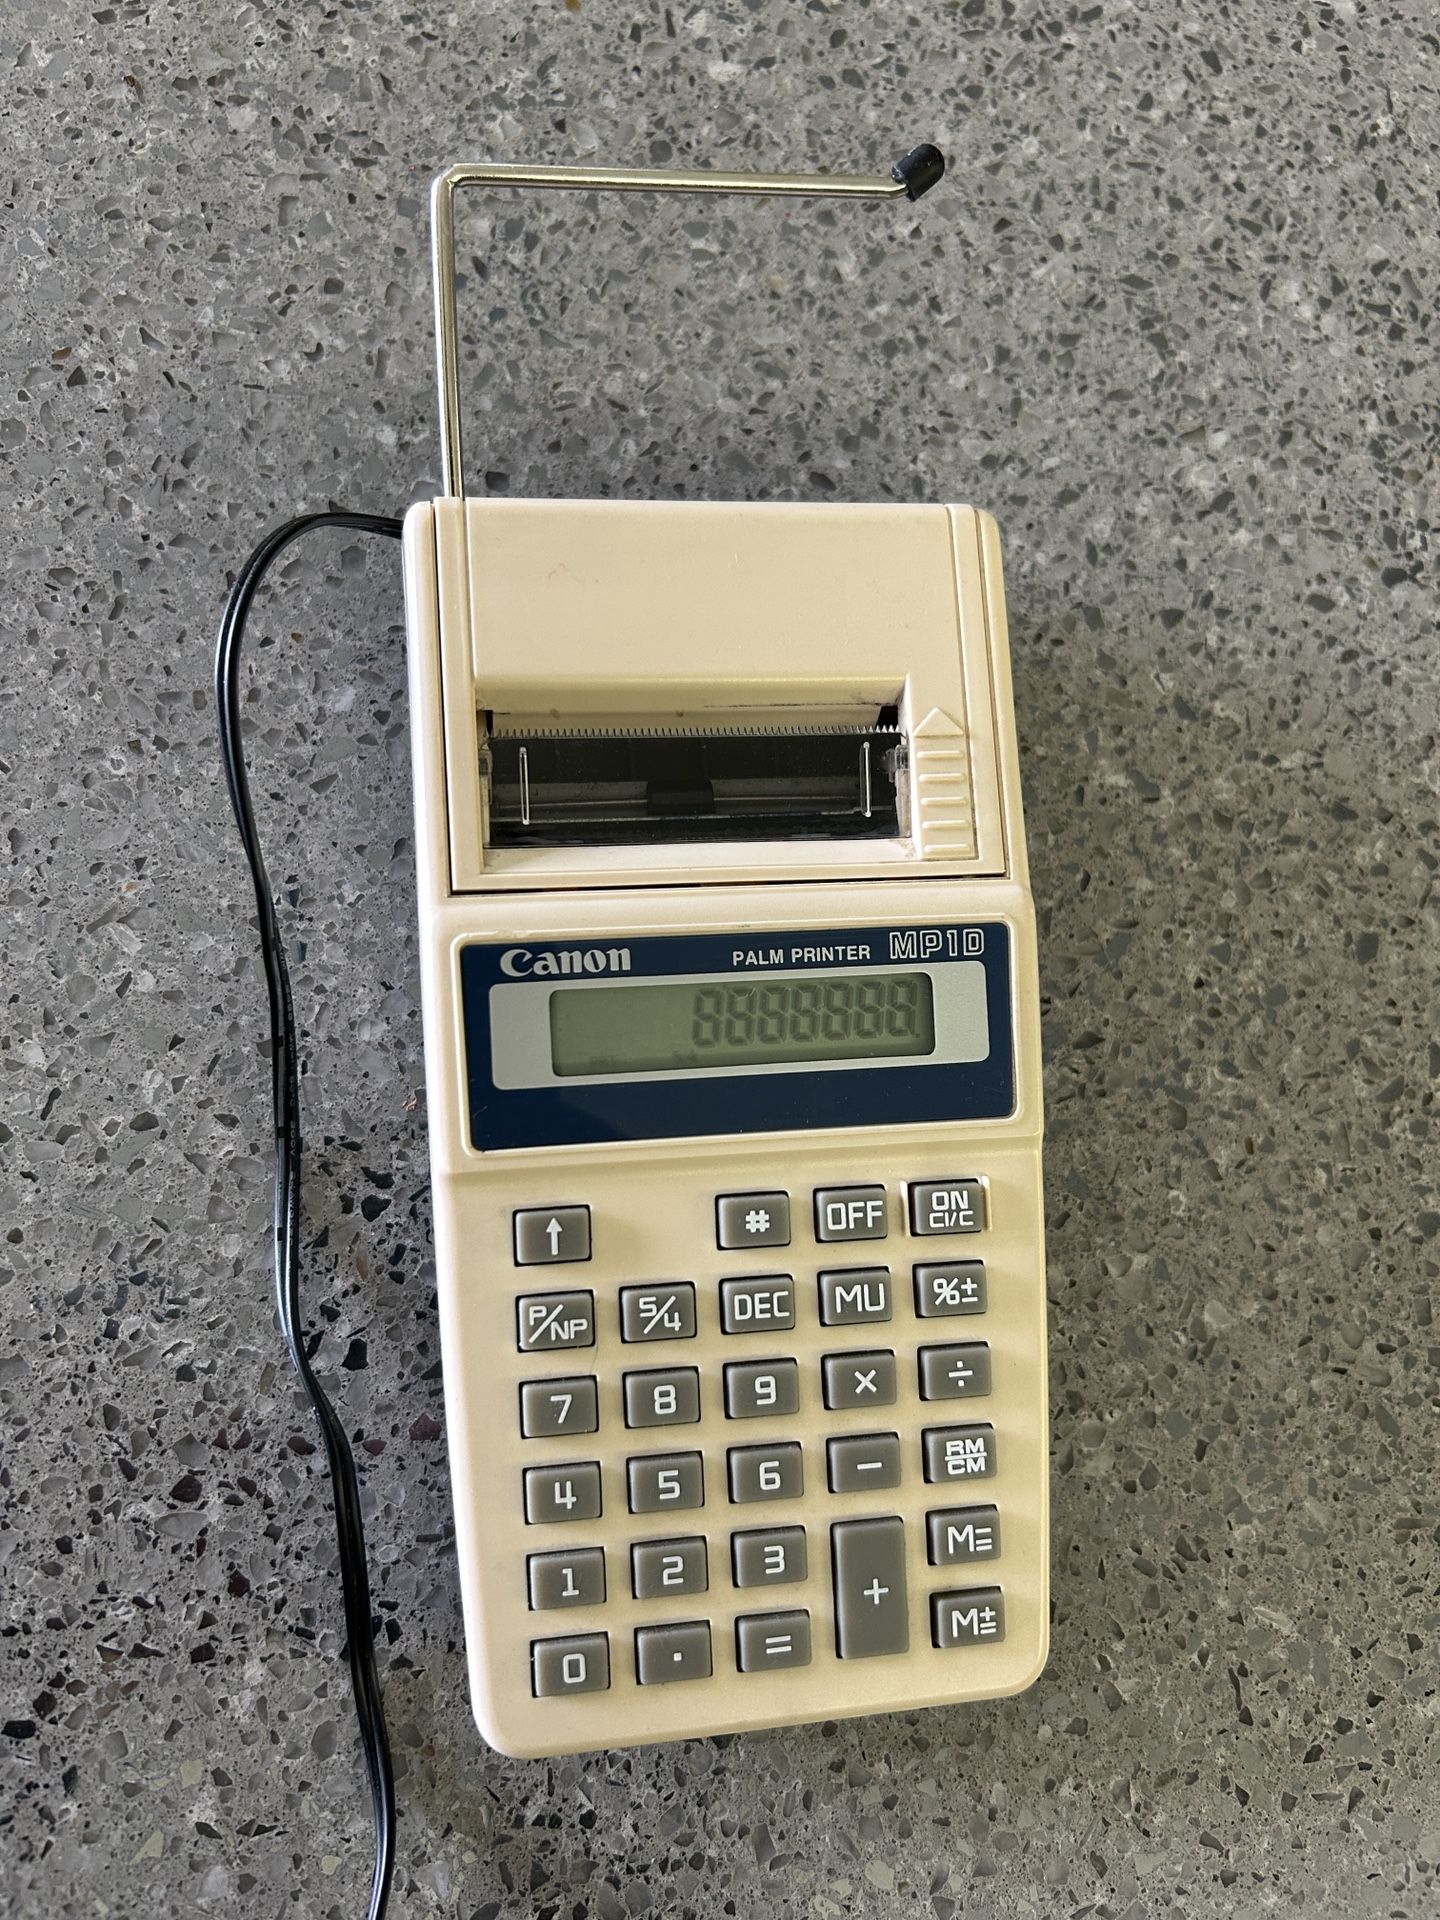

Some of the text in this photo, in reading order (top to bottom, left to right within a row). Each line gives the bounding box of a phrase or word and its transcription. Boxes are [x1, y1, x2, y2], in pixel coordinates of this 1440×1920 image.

[733, 928, 985, 966] PALM PRINTER MP1D
[500, 948, 631, 978] Canon
[932, 1190, 969, 1211] ON
[746, 1210, 769, 1232] #
[827, 1200, 883, 1231] OFF
[734, 1291, 789, 1320] DEC
[836, 1283, 884, 1313] MU
[639, 1296, 681, 1334] 5/4
[654, 1385, 676, 1414] 8
[755, 1376, 776, 1405] 9
[551, 1395, 571, 1423] 7
[945, 1437, 985, 1456] RM
[760, 1461, 780, 1490] 6
[947, 1457, 986, 1475] CM
[555, 1481, 576, 1509] 4
[659, 1470, 680, 1499] 5
[663, 1556, 683, 1585] 2
[764, 1546, 784, 1574] 3
[562, 1568, 579, 1596] 1
[864, 1579, 888, 1604] +
[766, 1636, 791, 1654] =
